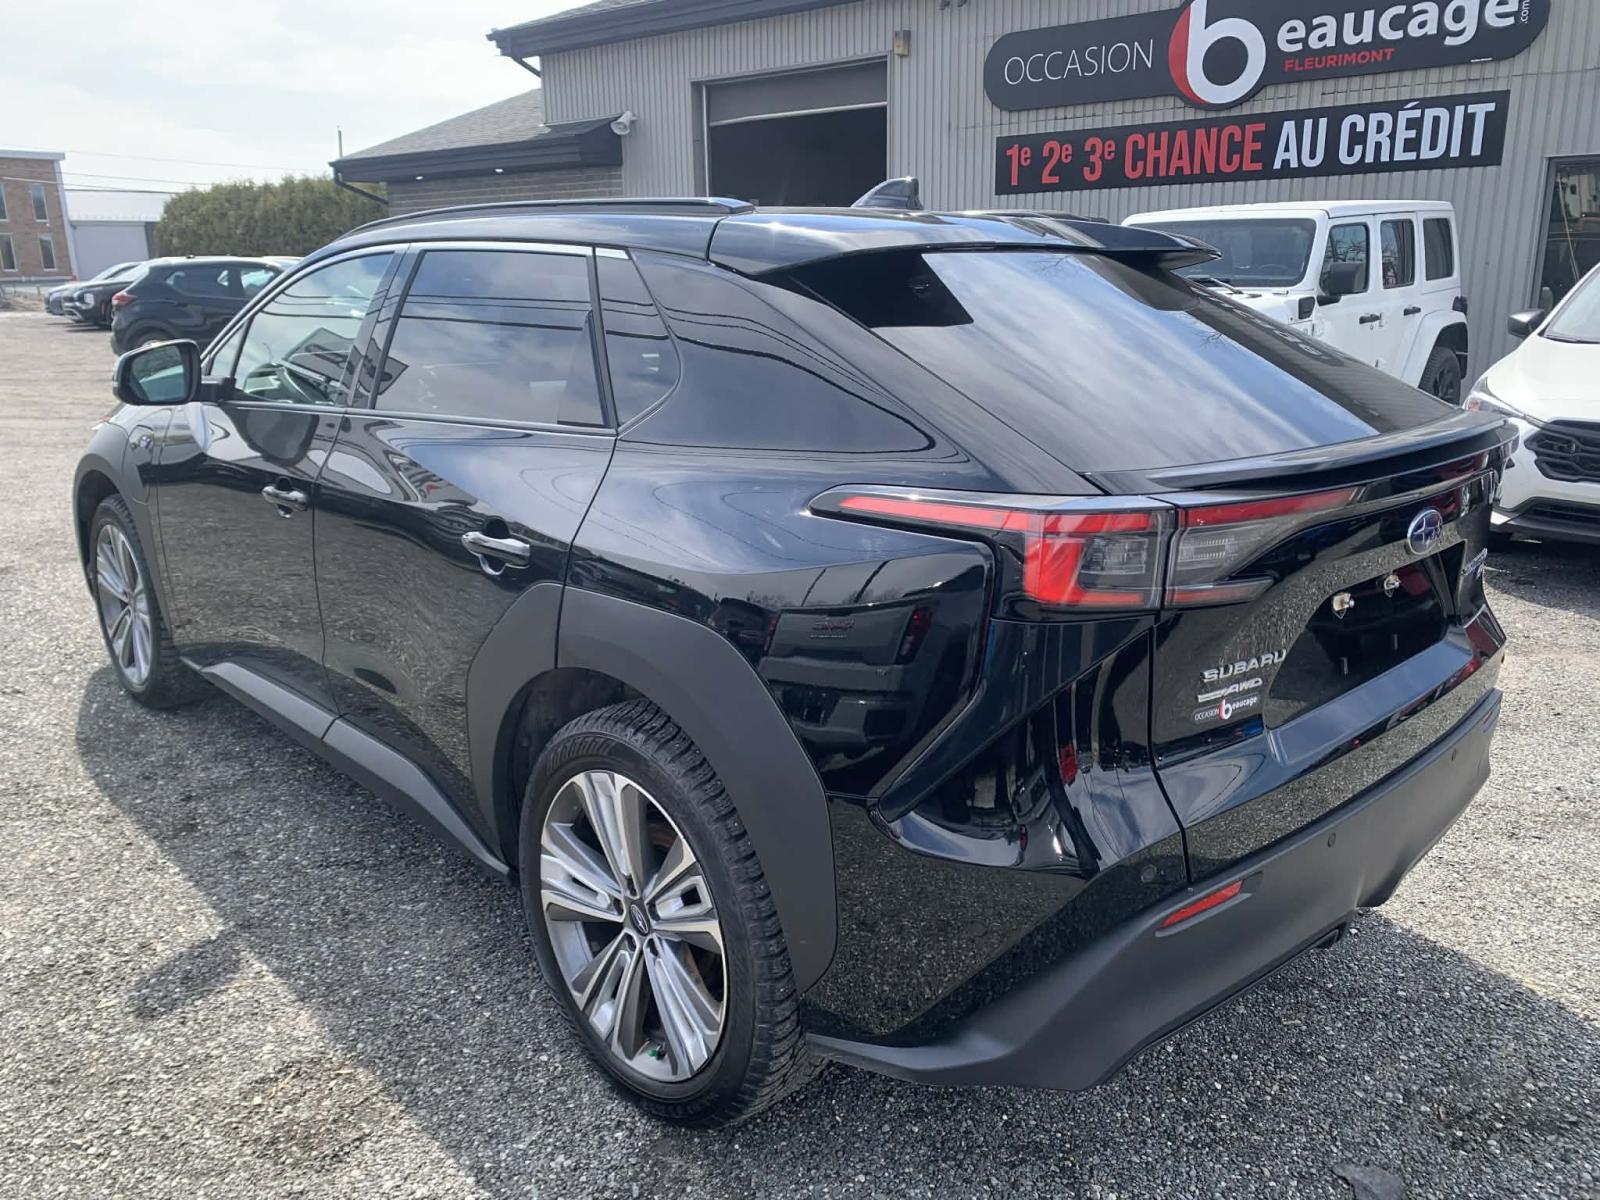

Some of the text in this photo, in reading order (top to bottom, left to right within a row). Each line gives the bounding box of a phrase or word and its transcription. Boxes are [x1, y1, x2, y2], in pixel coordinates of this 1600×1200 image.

[1004, 39, 1154, 85] OCCASION
[1284, 48, 1396, 72] FLEURIMONT
[1006, 101, 1496, 186] 1e 2e 3e CHANCE AU CRÉDIT
[1203, 649, 1287, 683] SUBARU
